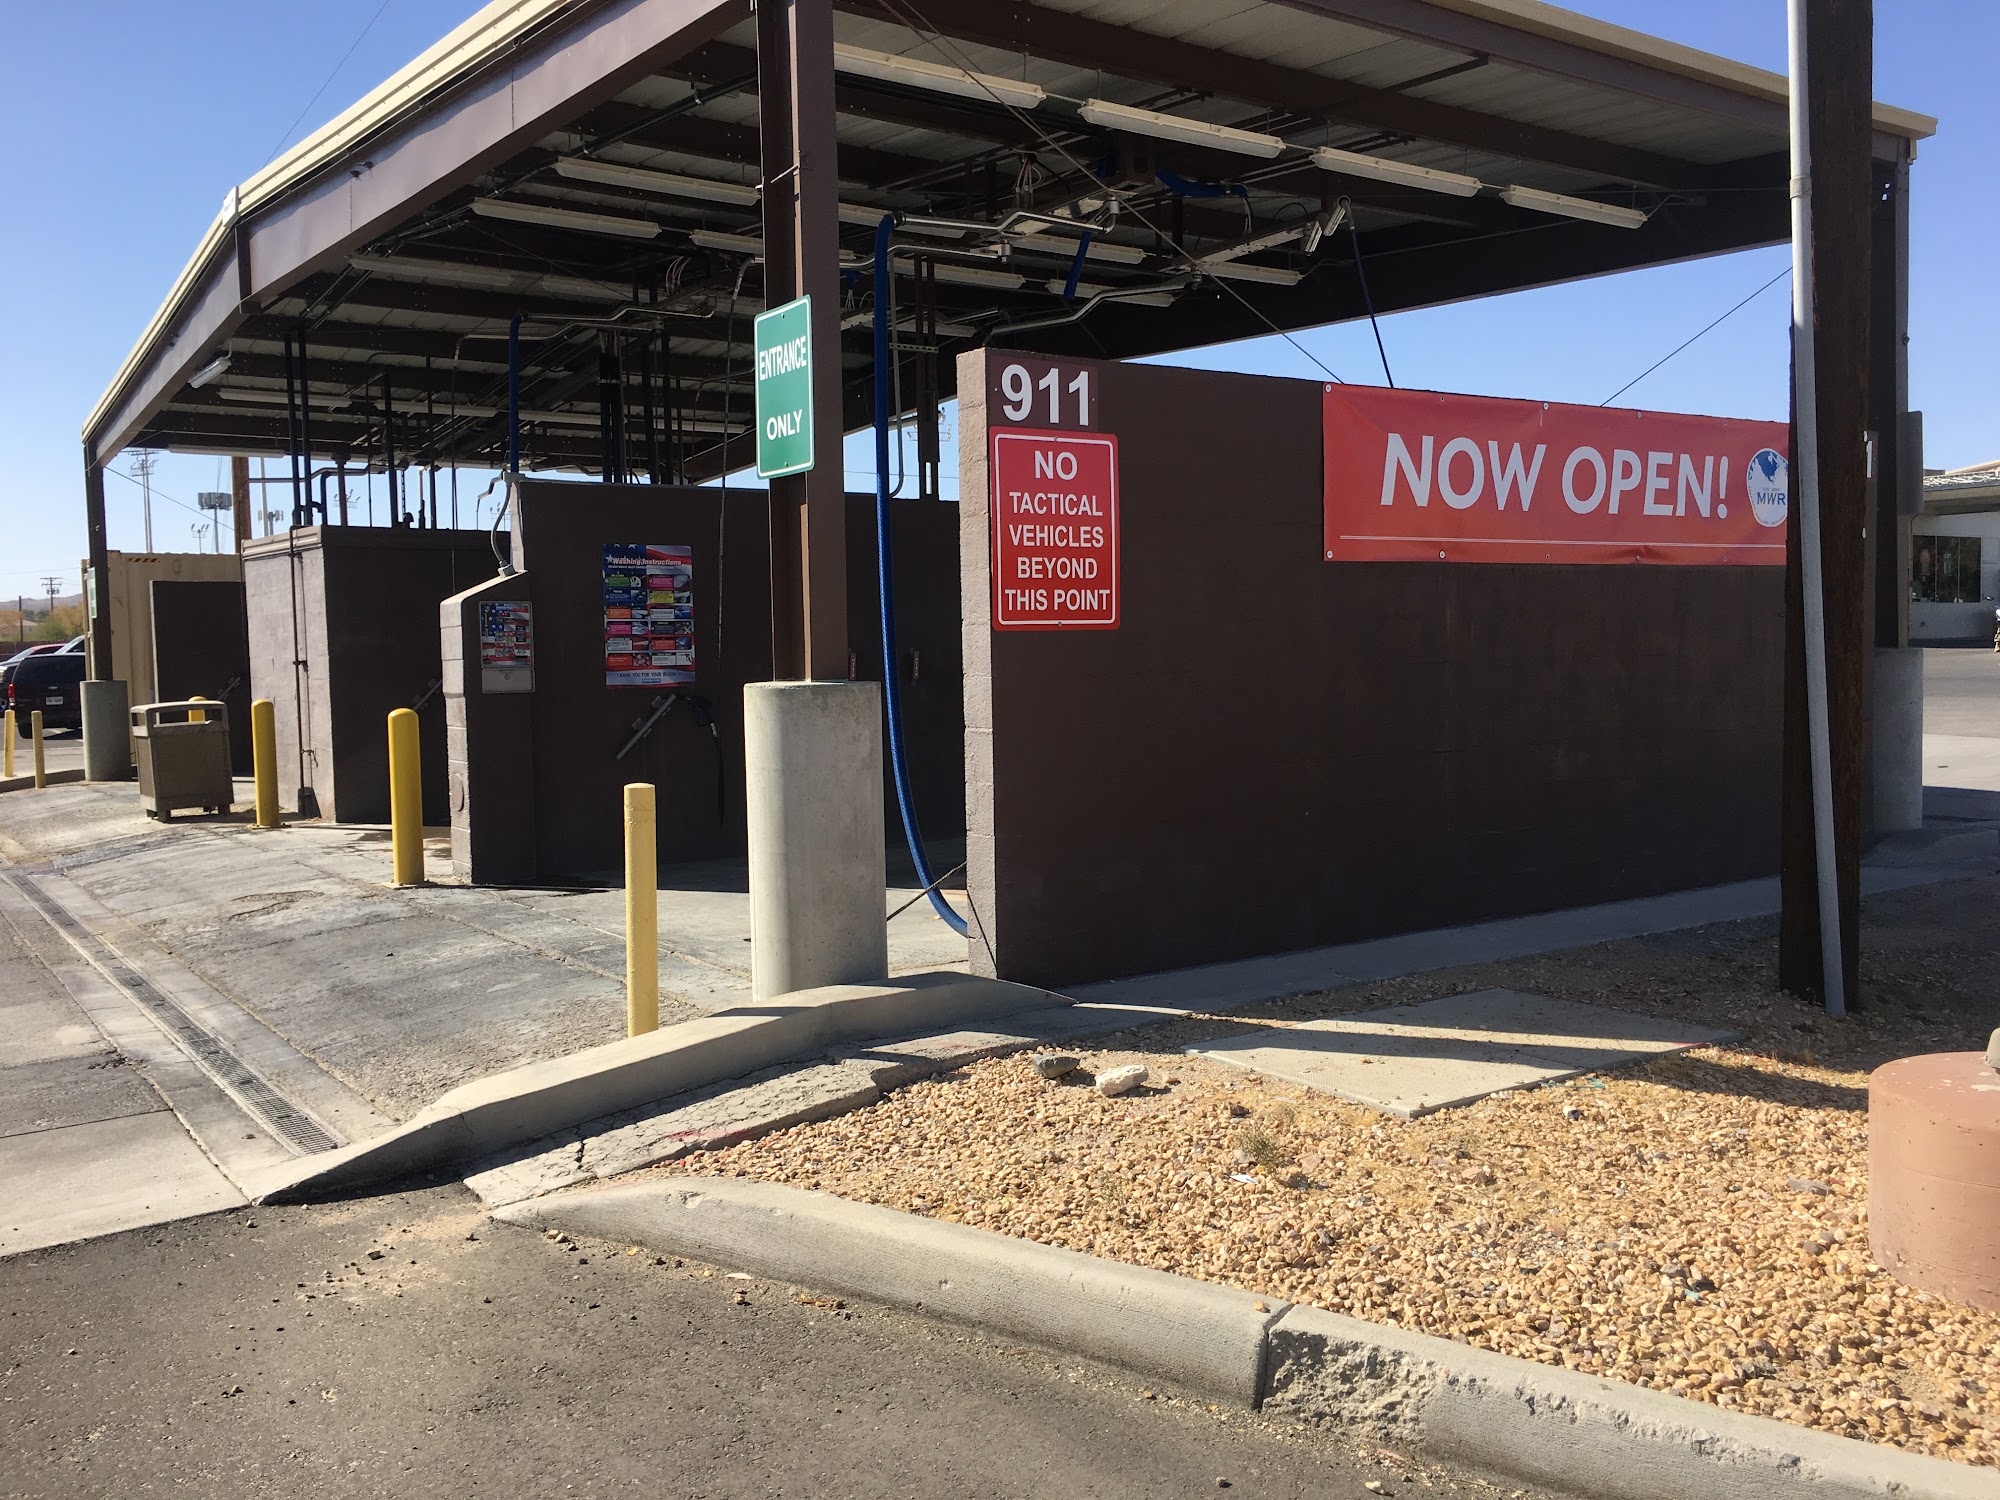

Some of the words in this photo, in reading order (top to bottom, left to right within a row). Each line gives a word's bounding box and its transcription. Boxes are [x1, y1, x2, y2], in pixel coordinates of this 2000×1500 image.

[759, 336, 807, 381] ENTRANCE
[1001, 364, 1089, 426] 911
[766, 409, 803, 440] ONLY
[1034, 450, 1078, 481] NO
[1380, 432, 1547, 512] NOW
[1561, 445, 1729, 520] OPEN!
[1009, 491, 1103, 517] TACTICAL
[1756, 492, 1787, 505] MWR
[1008, 524, 1104, 549] VEHICLES
[613, 558, 642, 566] Washing
[642, 558, 682, 566] Instructions
[1017, 556, 1098, 580] BEYOND
[1004, 589, 1048, 611] THIS
[1054, 589, 1110, 611] POINT
